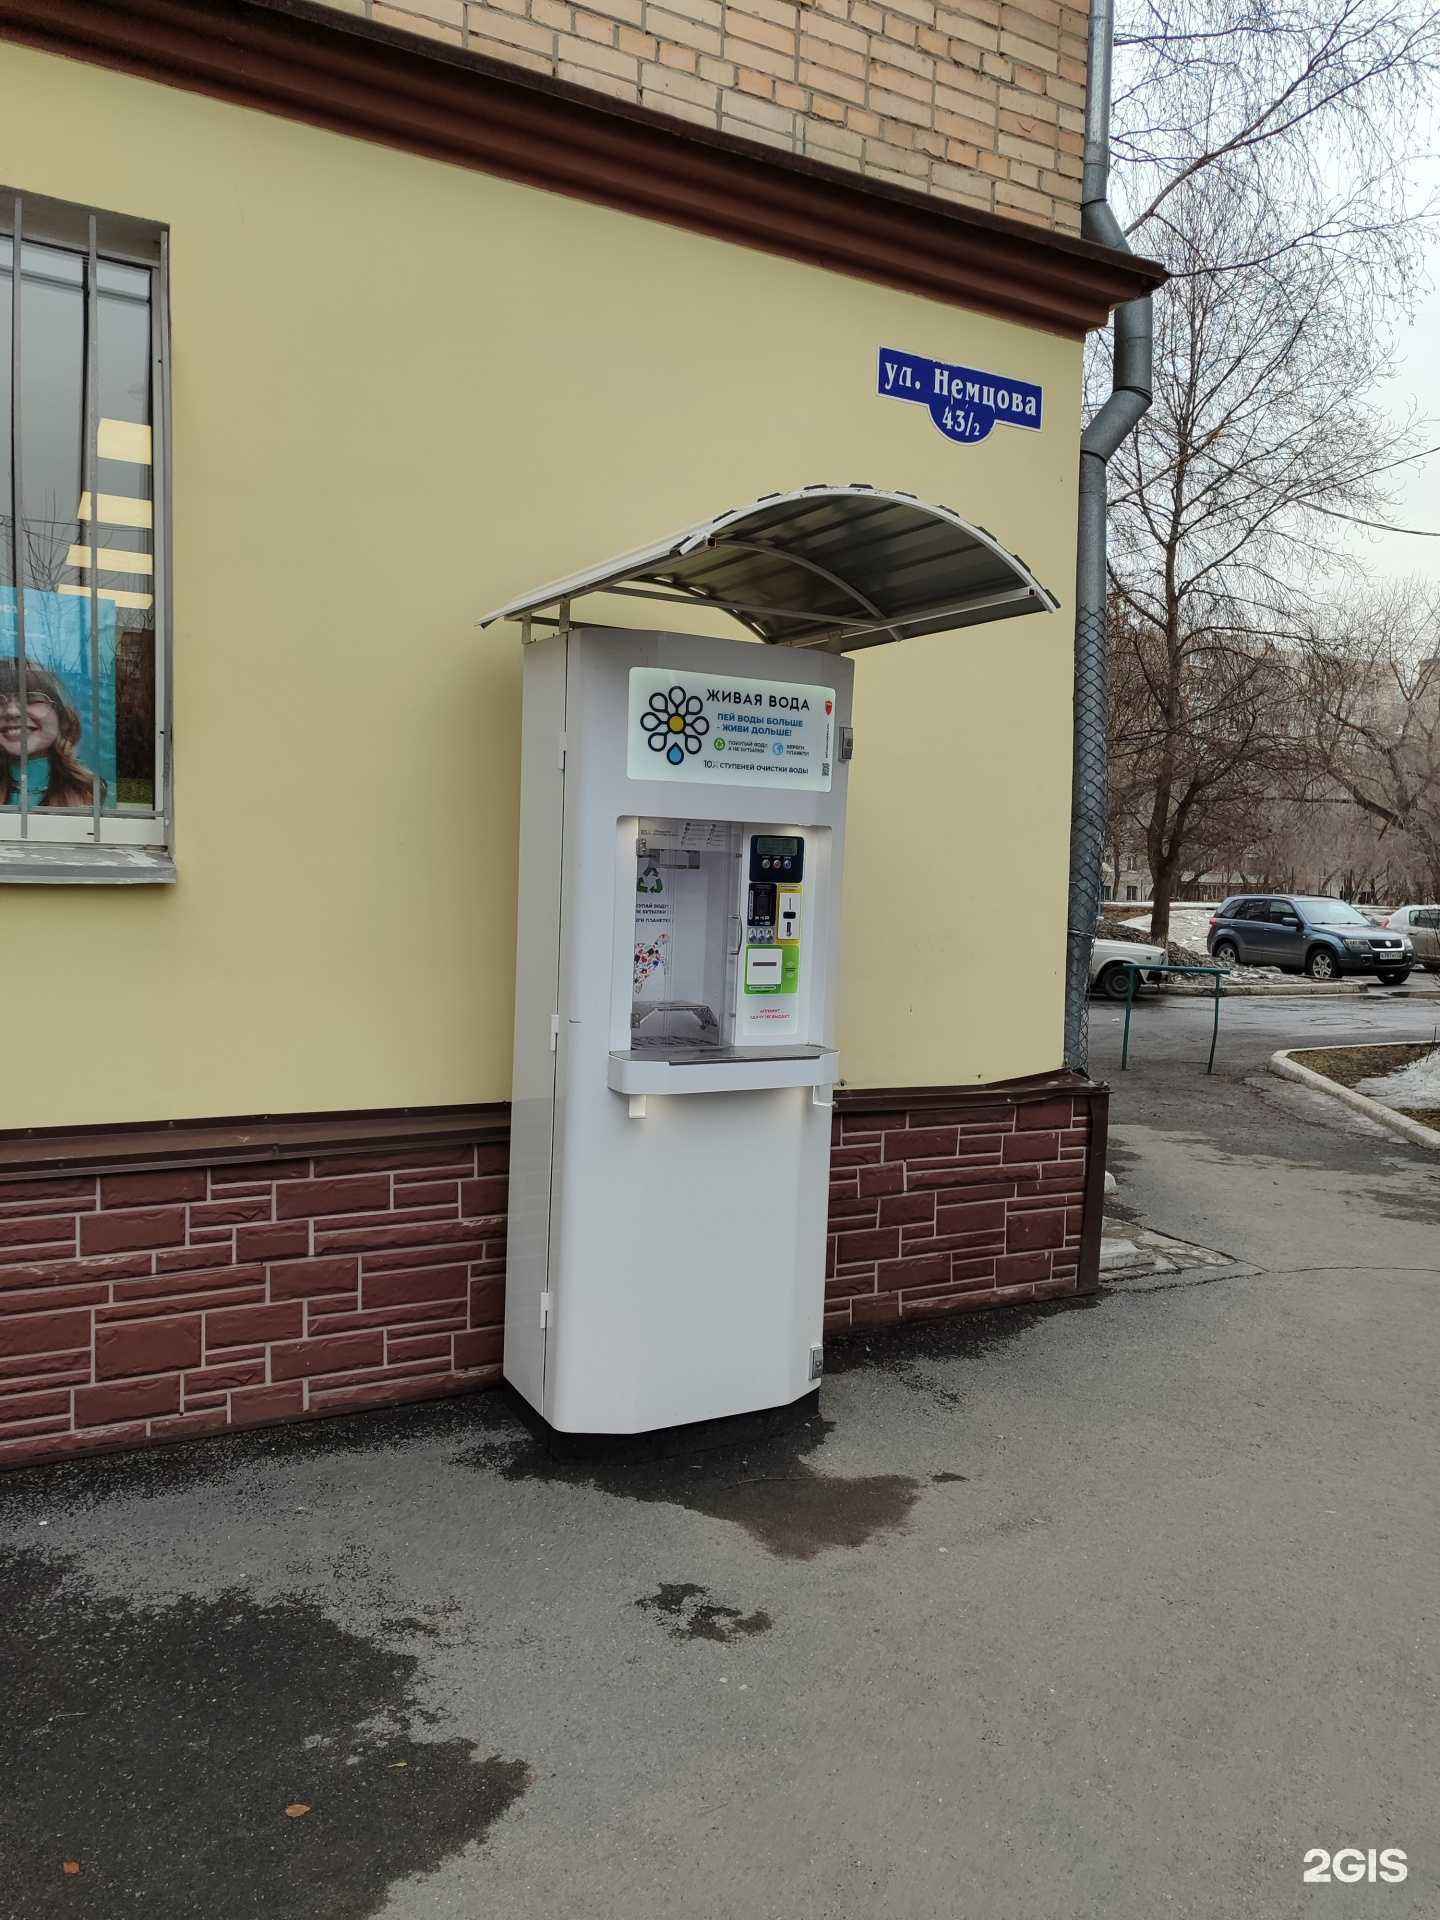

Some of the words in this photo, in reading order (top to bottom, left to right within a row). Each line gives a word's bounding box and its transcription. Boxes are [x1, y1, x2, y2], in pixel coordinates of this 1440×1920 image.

[885, 362, 921, 390] ул.
[933, 368, 1037, 416] Немцова
[942, 406, 980, 436] 43/2
[706, 688, 762, 706] ЖИВАЯ
[768, 695, 810, 711] ВОДА
[717, 712, 735, 721] ПЕЙ
[737, 714, 764, 724] ВОДЫ
[766, 717, 804, 727] БОЛЬШЕ
[722, 724, 749, 733] ЖИВИ
[751, 726, 792, 737] ДОЛЬШЕ!
[719, 762, 755, 771] СТУПЕНЕЙ
[756, 765, 788, 773] ОЧИСТКИ
[788, 767, 809, 775] ВОДЫ
